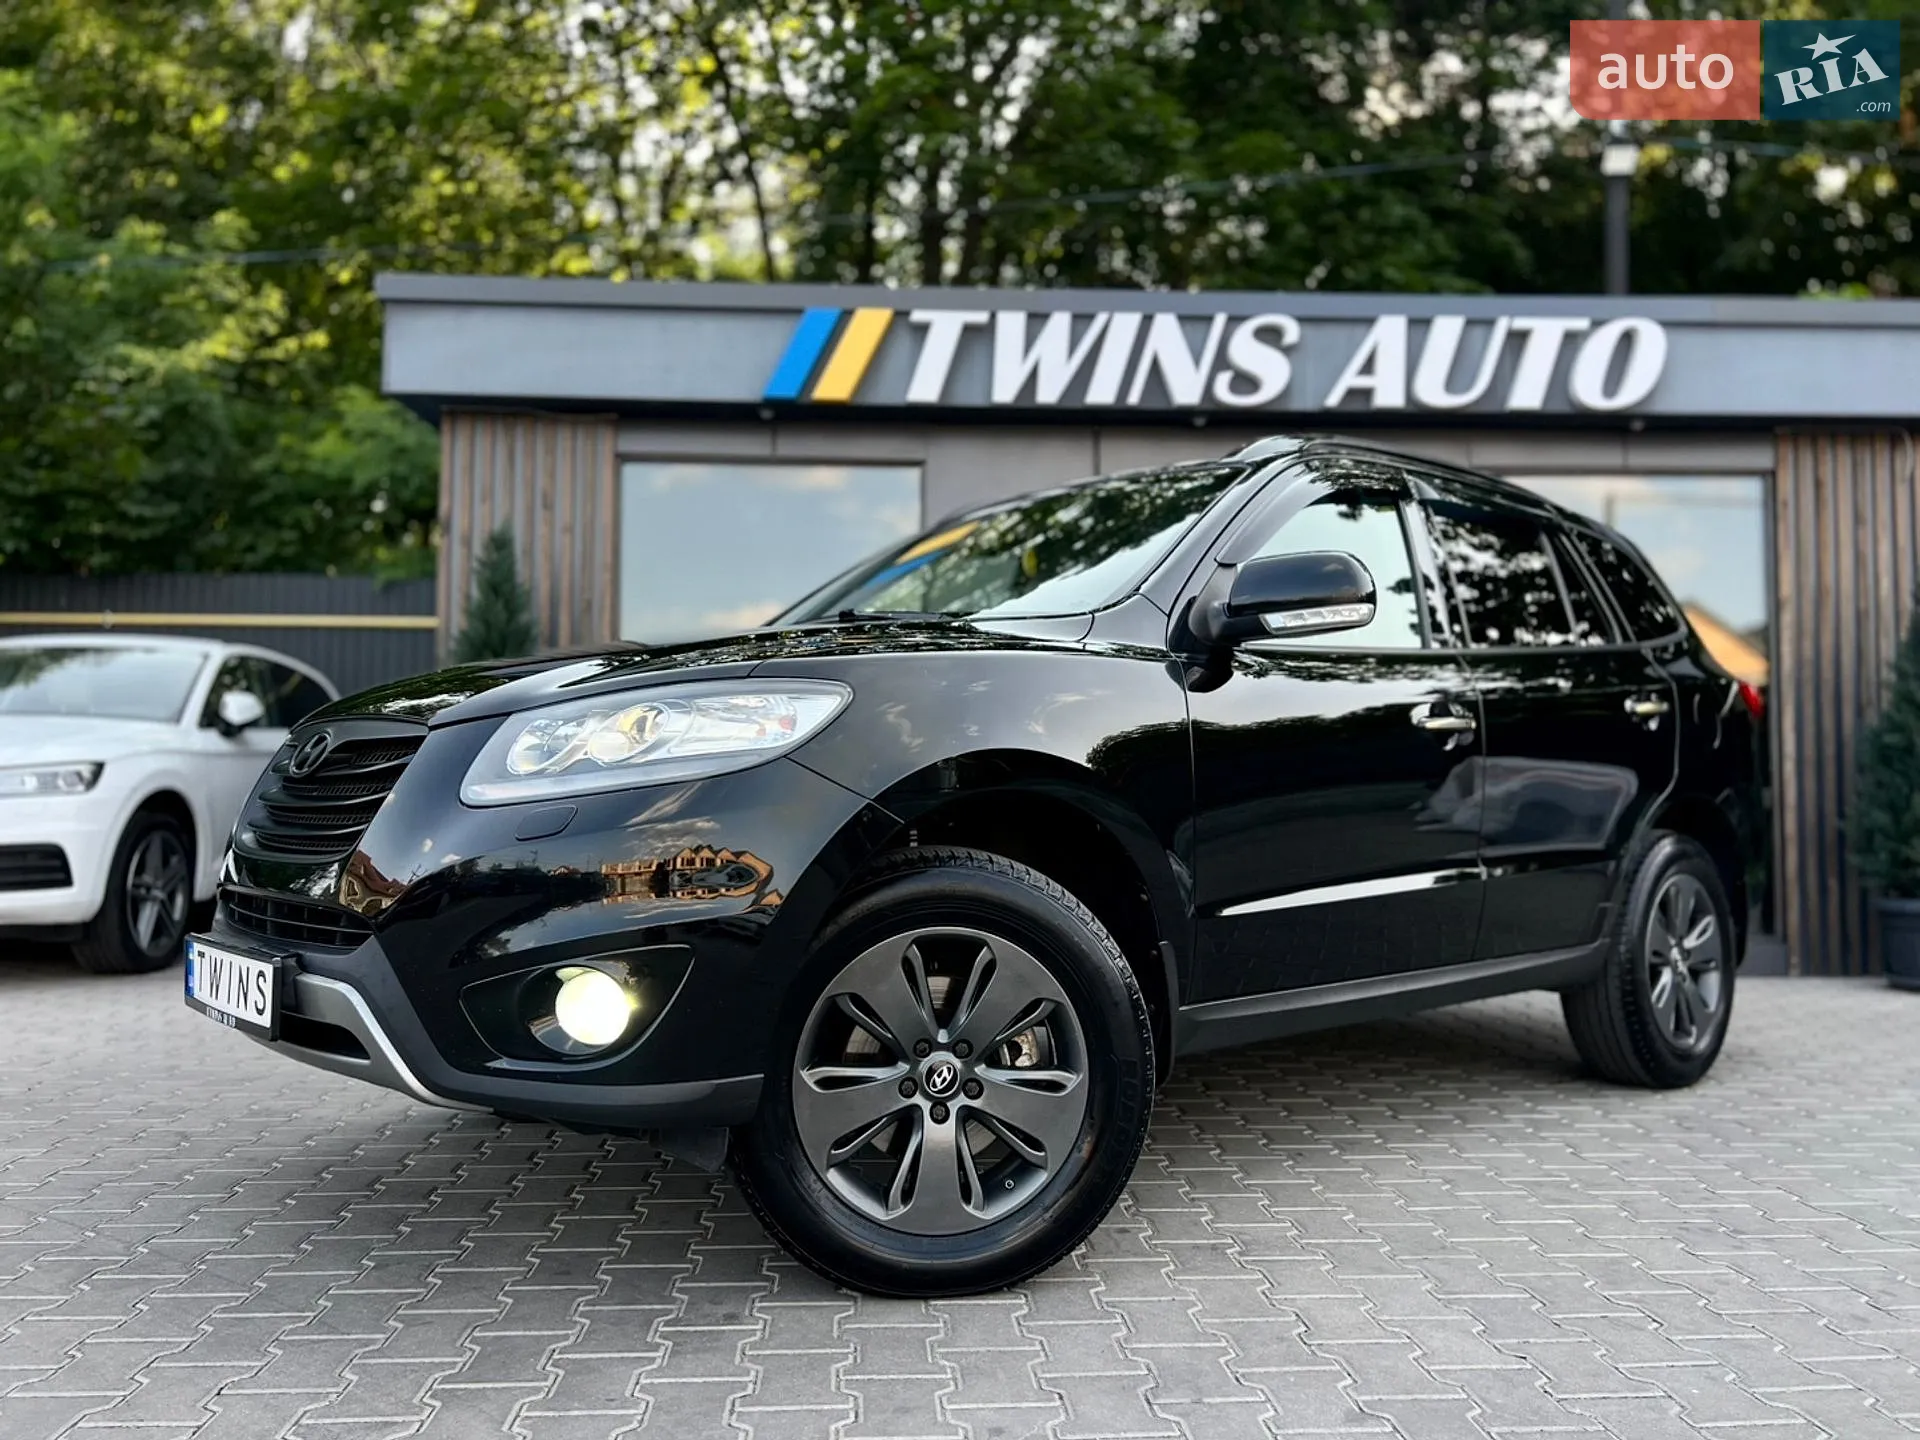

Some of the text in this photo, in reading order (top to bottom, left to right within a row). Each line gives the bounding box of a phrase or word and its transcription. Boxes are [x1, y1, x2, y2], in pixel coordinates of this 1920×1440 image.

[906, 310, 1669, 413] TWINS AUTO
[197, 950, 267, 1016] TWINS
